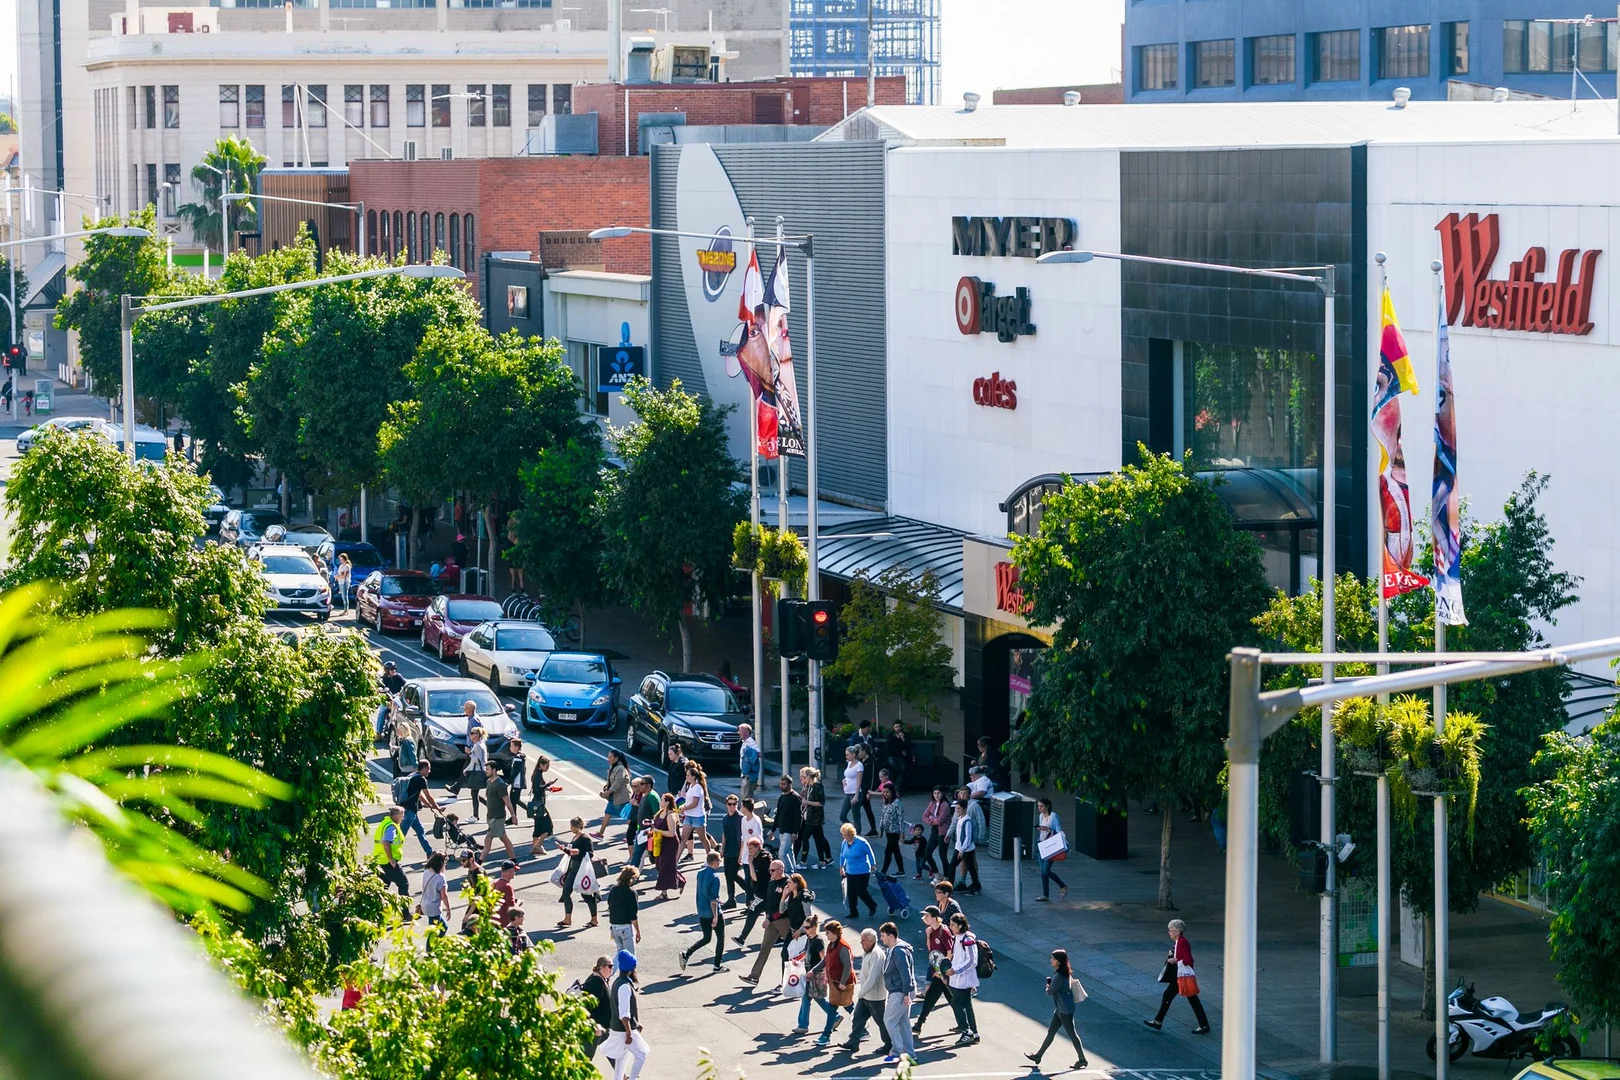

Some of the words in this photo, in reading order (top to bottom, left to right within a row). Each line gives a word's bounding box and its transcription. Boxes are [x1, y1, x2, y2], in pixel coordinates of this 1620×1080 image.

[951, 216, 1076, 258] MYER
[696, 249, 736, 267] TIMEZONE
[1434, 212, 1603, 336] Westfield
[608, 373, 636, 384] ANZ
[973, 371, 1018, 411] coles
